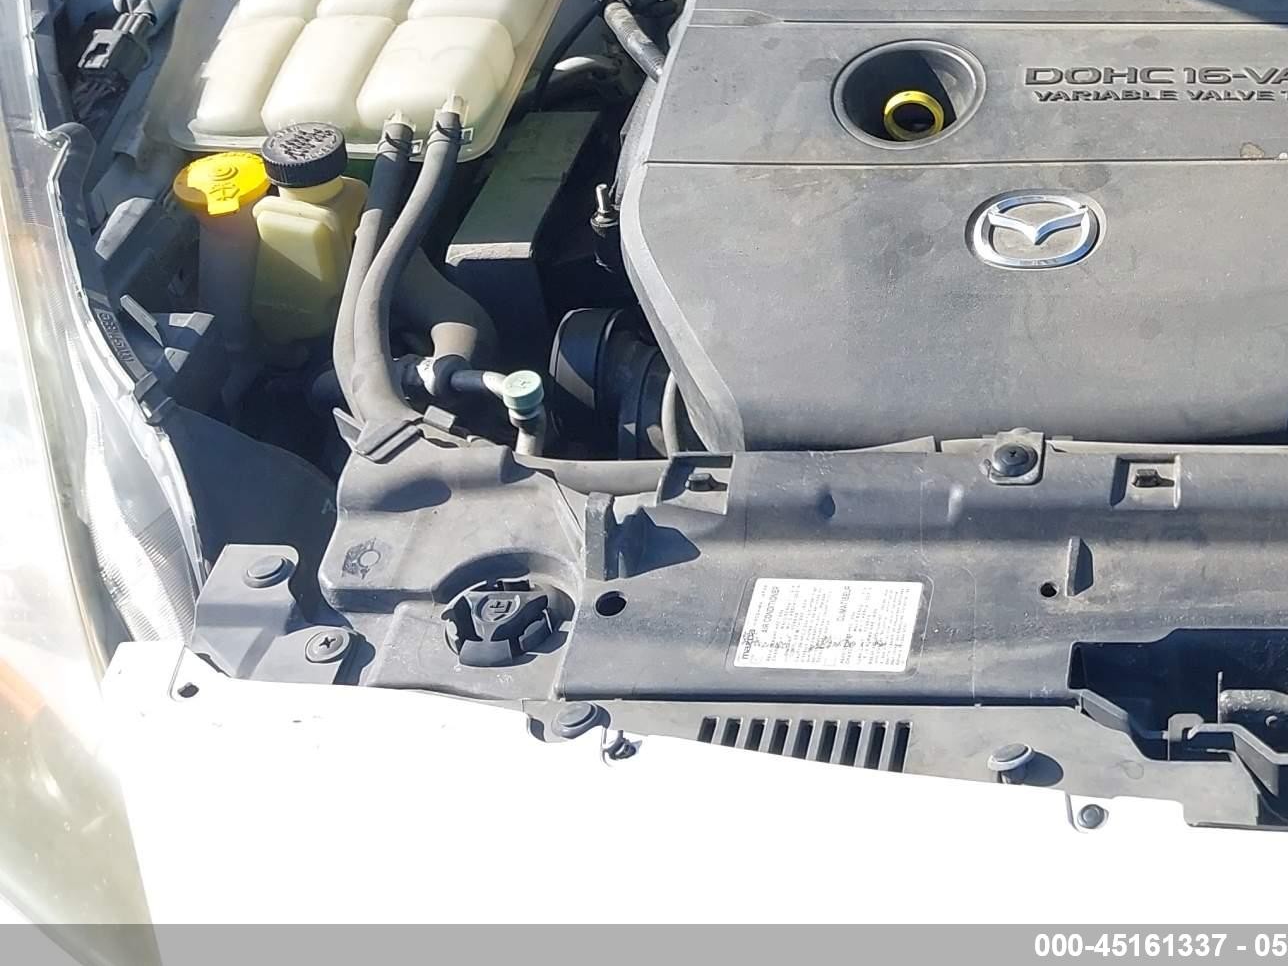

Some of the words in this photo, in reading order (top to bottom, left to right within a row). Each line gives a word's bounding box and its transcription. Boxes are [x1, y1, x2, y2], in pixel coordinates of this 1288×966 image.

[1025, 66, 1176, 86] DOHC
[1034, 89, 1179, 103] VARIABLE
[1190, 89, 1276, 102] VALVE
[763, 586, 780, 623] CONDITIONER
